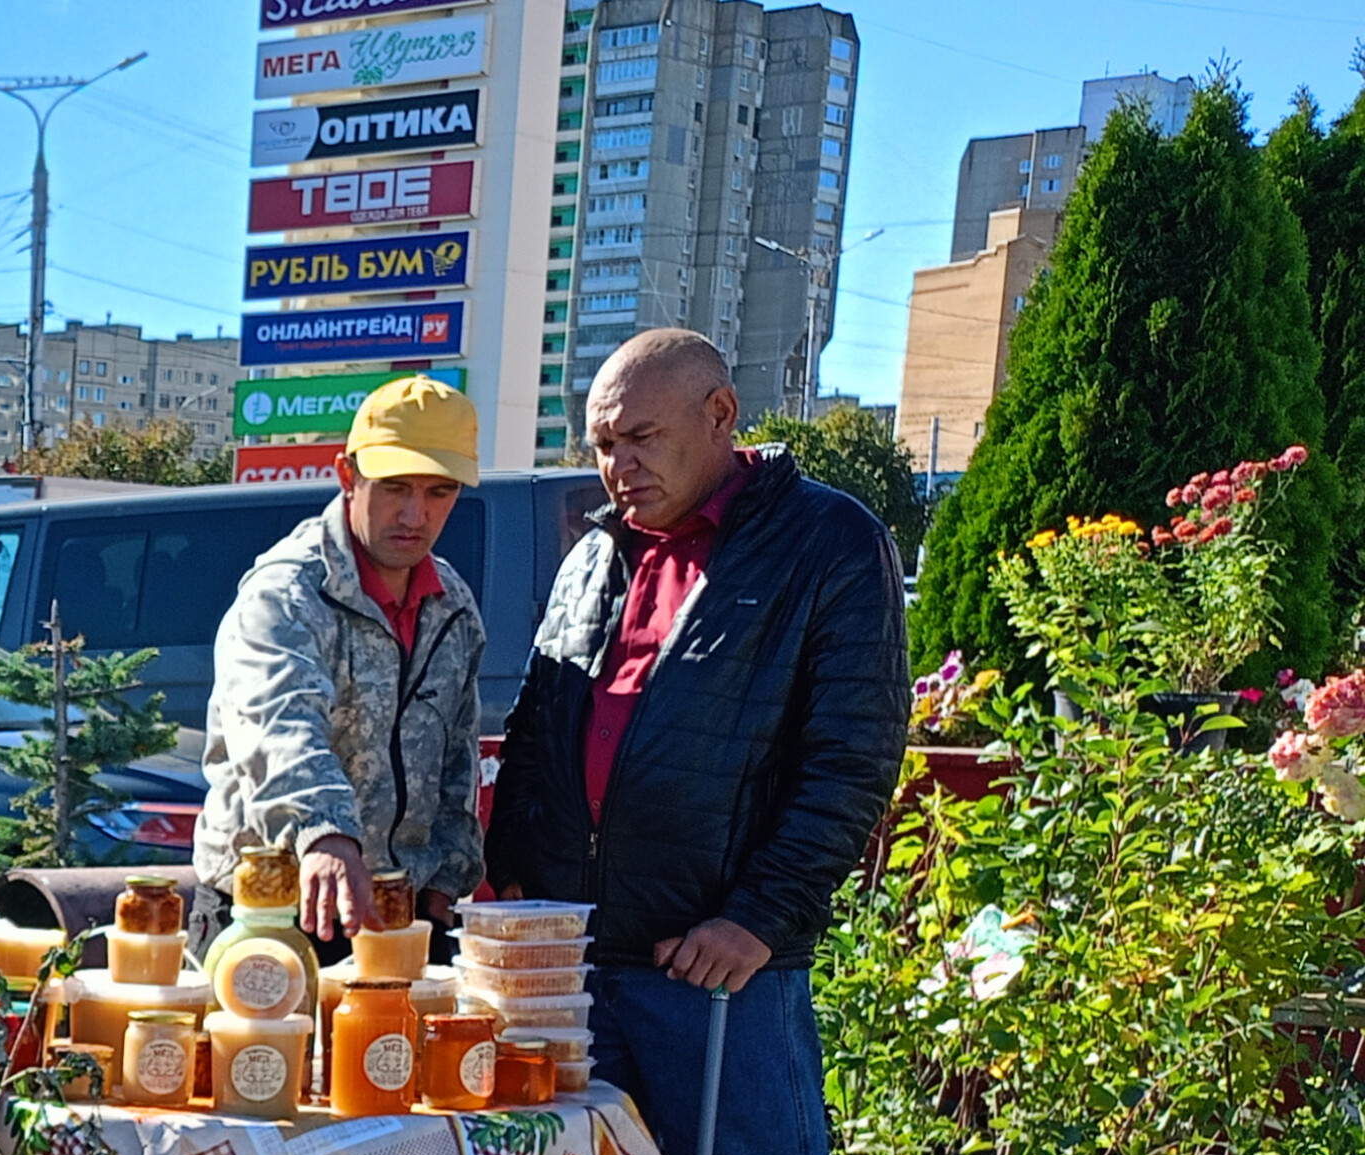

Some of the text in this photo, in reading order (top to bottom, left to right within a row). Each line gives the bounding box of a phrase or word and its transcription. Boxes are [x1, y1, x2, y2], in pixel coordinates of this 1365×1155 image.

[263, 50, 341, 79] МЕГА
[320, 103, 473, 146] ОПТИКА
[291, 167, 432, 215] ТВОЕ
[250, 248, 424, 287] РУБЛЬ БУМ
[256, 314, 413, 342] ОНЛАЙНТРЕЙД
[277, 390, 368, 417] МЕГАФ
